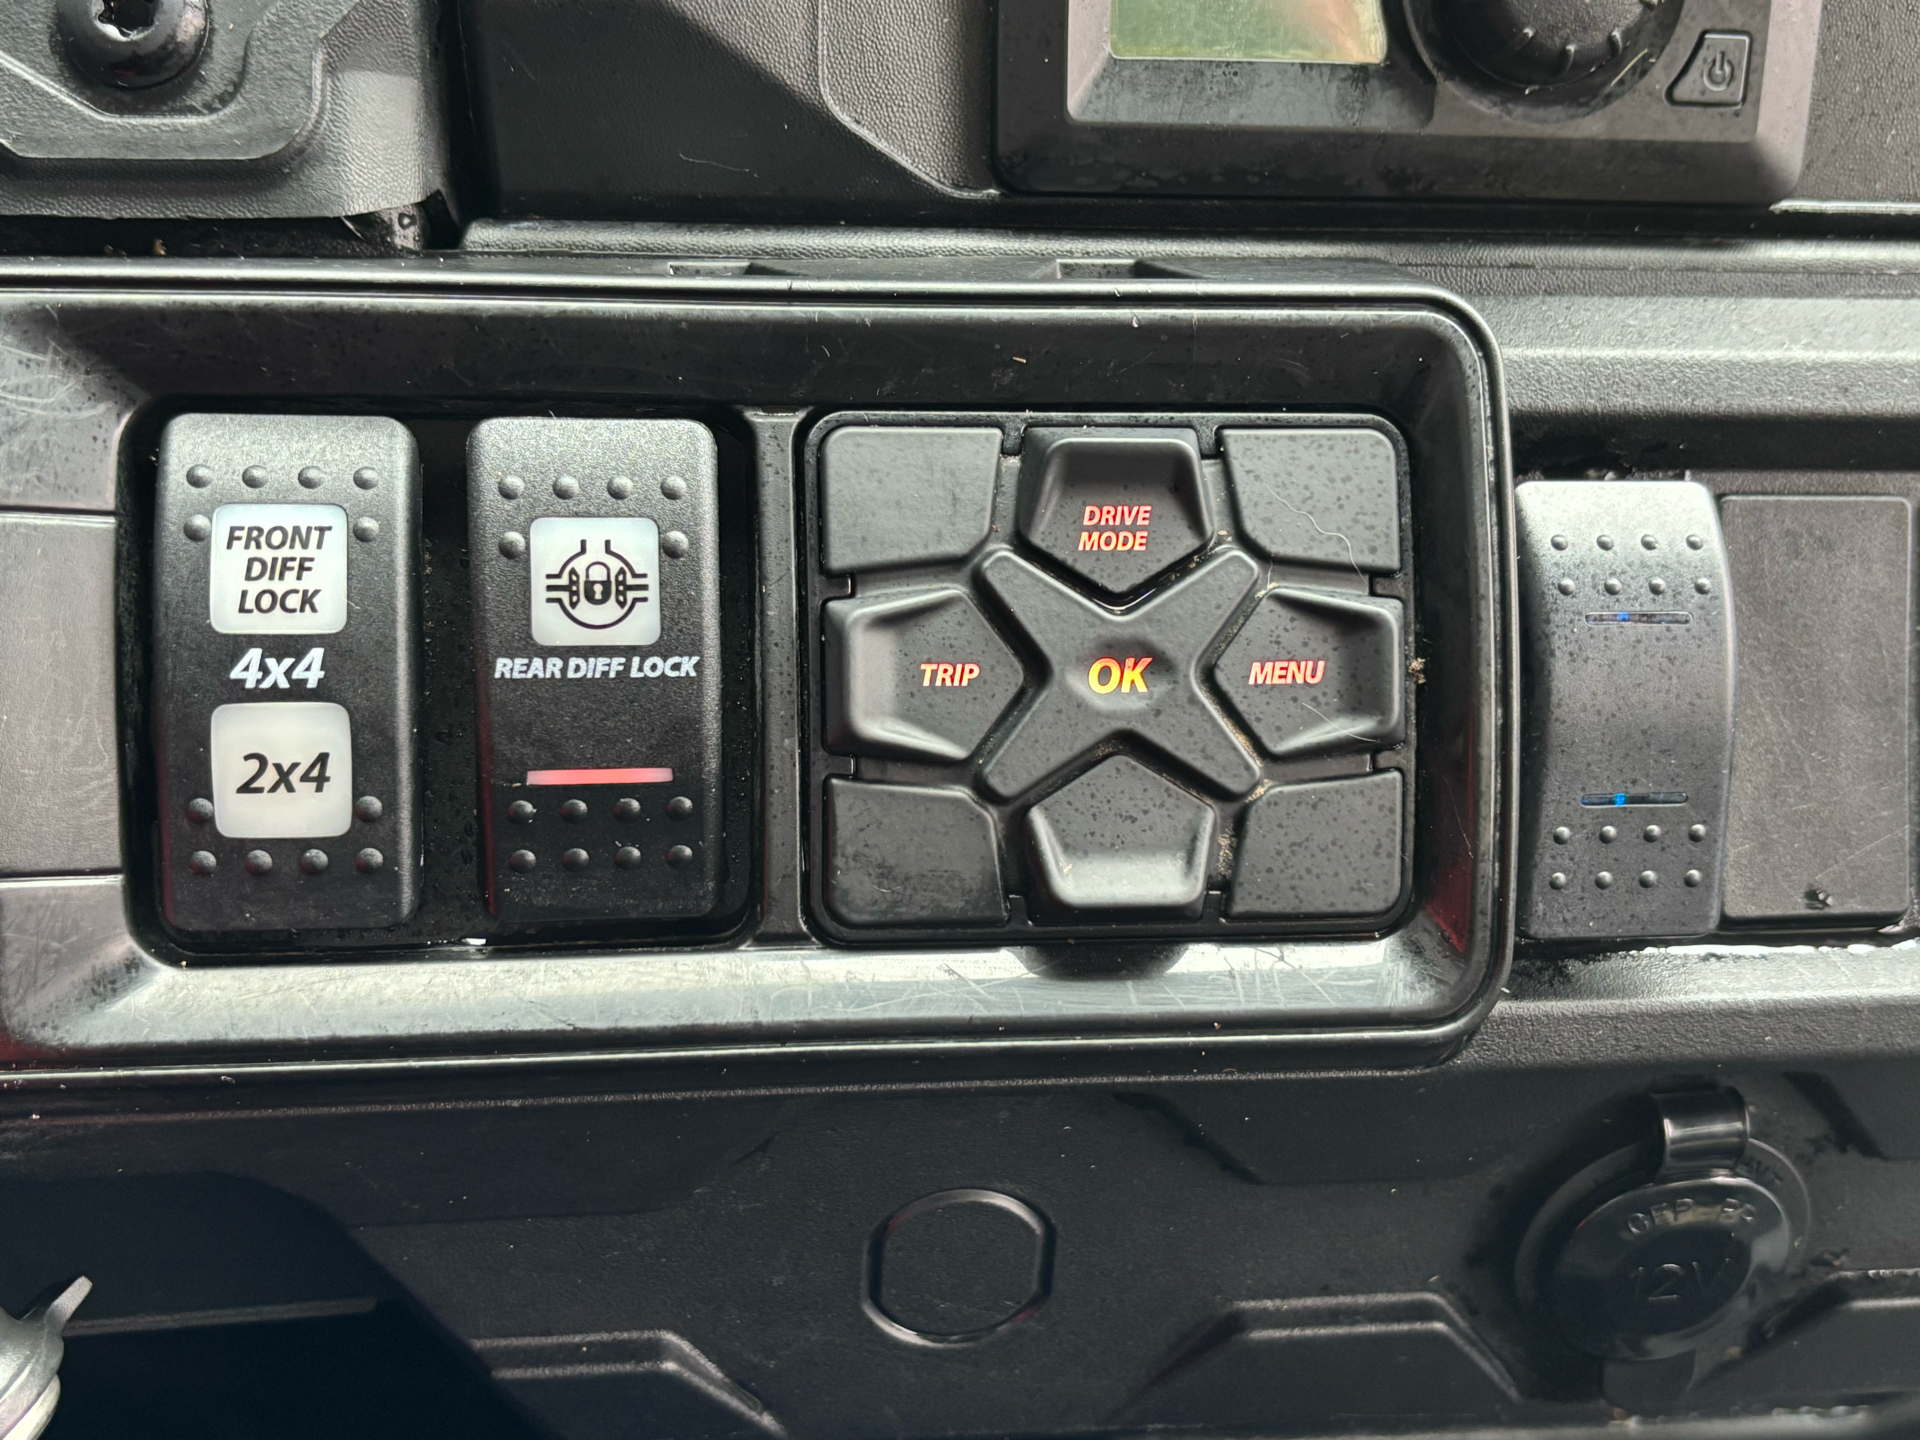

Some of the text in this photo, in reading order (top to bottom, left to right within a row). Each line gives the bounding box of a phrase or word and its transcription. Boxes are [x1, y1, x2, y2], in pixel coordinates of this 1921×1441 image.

[1083, 505, 1151, 525] DRIVE
[227, 526, 332, 550] FRONT
[1078, 531, 1148, 551] MODE
[245, 557, 314, 582] DIFF
[238, 589, 321, 614] LOCK
[230, 647, 325, 688] 4x4
[494, 656, 700, 679] REAR DIFF LOCK
[920, 663, 980, 687] TRIP
[1087, 657, 1152, 694] OK
[1249, 661, 1325, 685] MENU
[236, 752, 331, 794] 2x4
[1629, 1257, 1732, 1303] 12V
